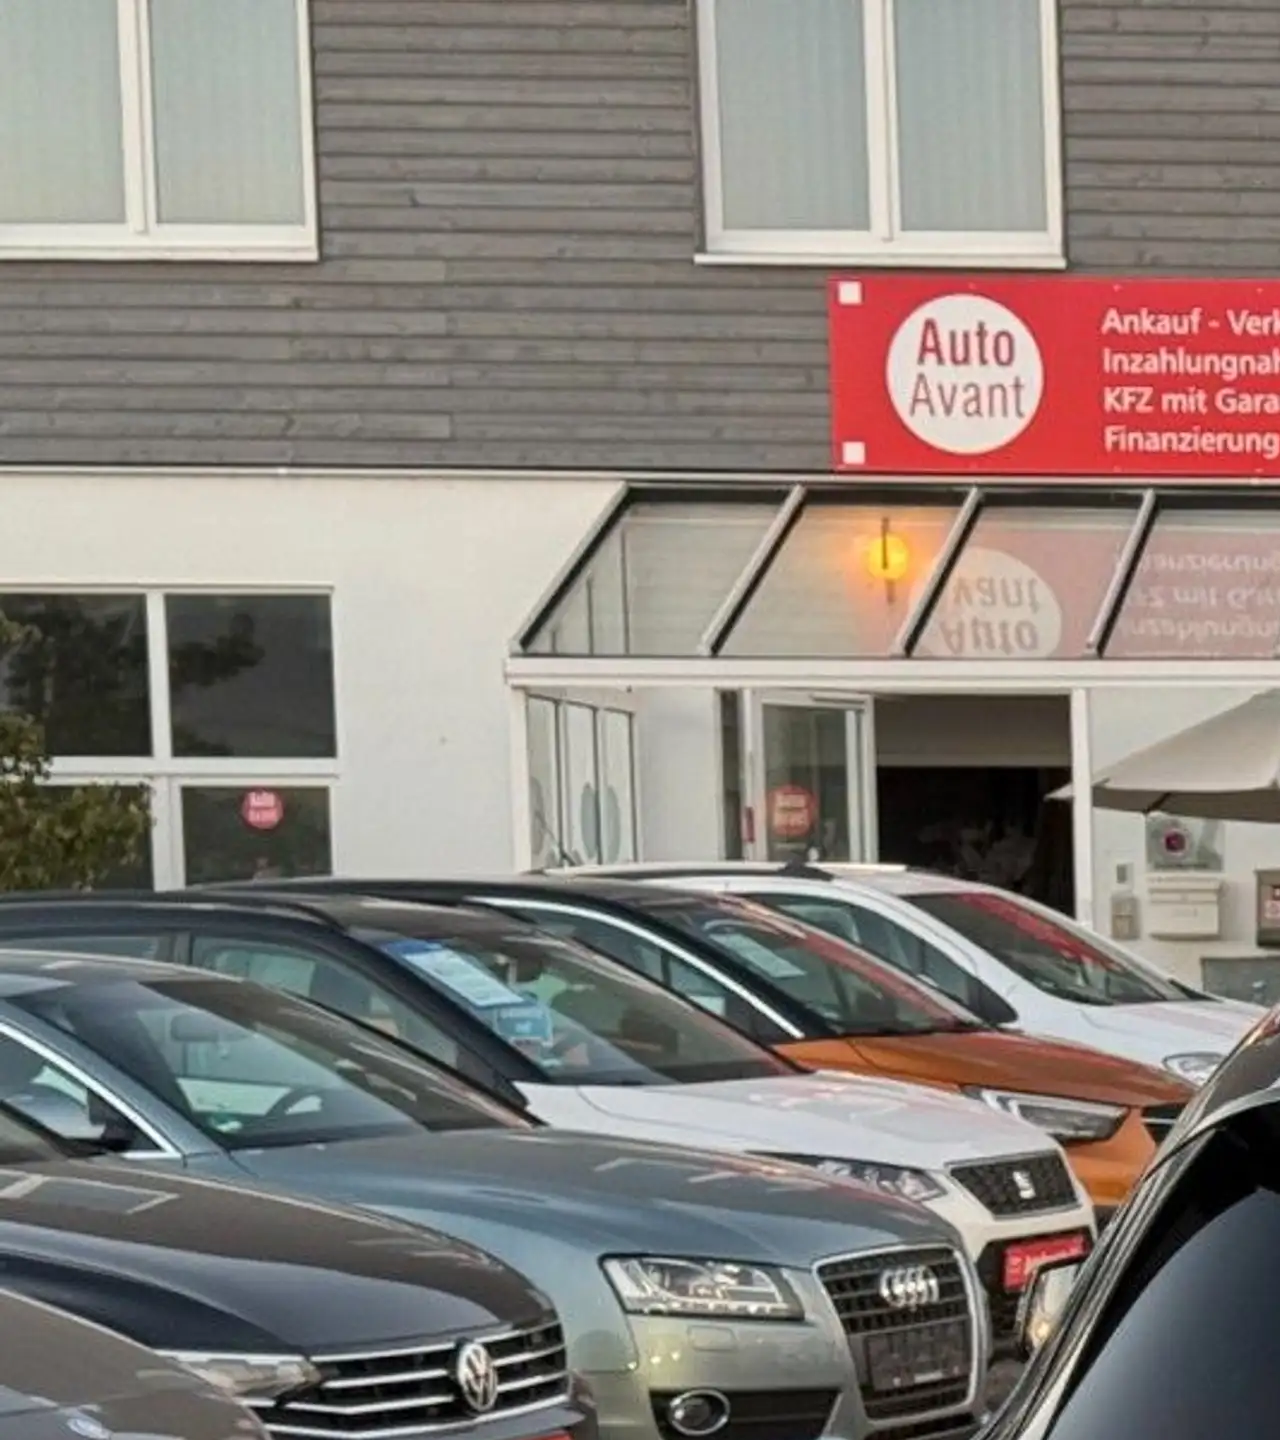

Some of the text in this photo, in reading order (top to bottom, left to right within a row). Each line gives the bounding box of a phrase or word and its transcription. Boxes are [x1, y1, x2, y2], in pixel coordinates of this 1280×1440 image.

[1102, 307, 1201, 335] Ankauf
[917, 318, 1015, 366] Auto
[909, 373, 1026, 419] Avant
[1104, 387, 1153, 414] KFZ
[1161, 387, 1208, 415] mit
[1104, 425, 1280, 459] Finanzierung
